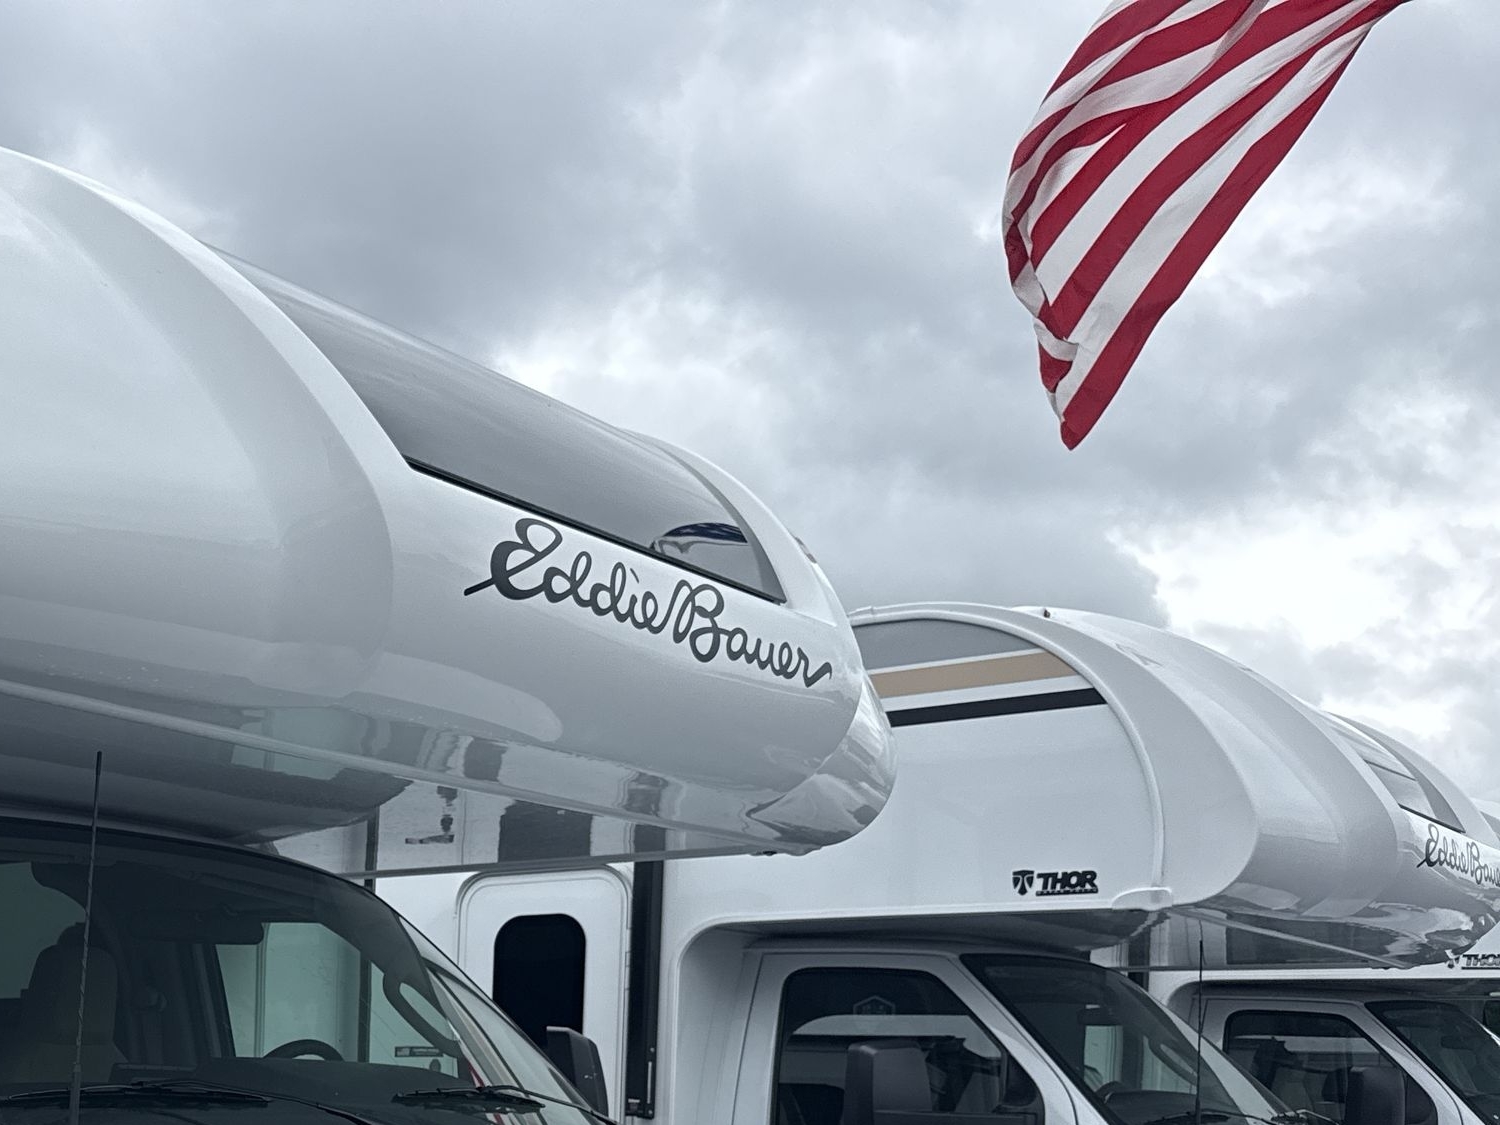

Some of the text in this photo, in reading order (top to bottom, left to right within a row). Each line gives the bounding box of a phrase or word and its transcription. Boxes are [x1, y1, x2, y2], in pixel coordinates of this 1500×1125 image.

[463, 518, 833, 688] Eddie Bauer
[1416, 823, 1468, 874] Eddie
[1036, 870, 1099, 890] THOR
[1463, 953, 1500, 967] THO
